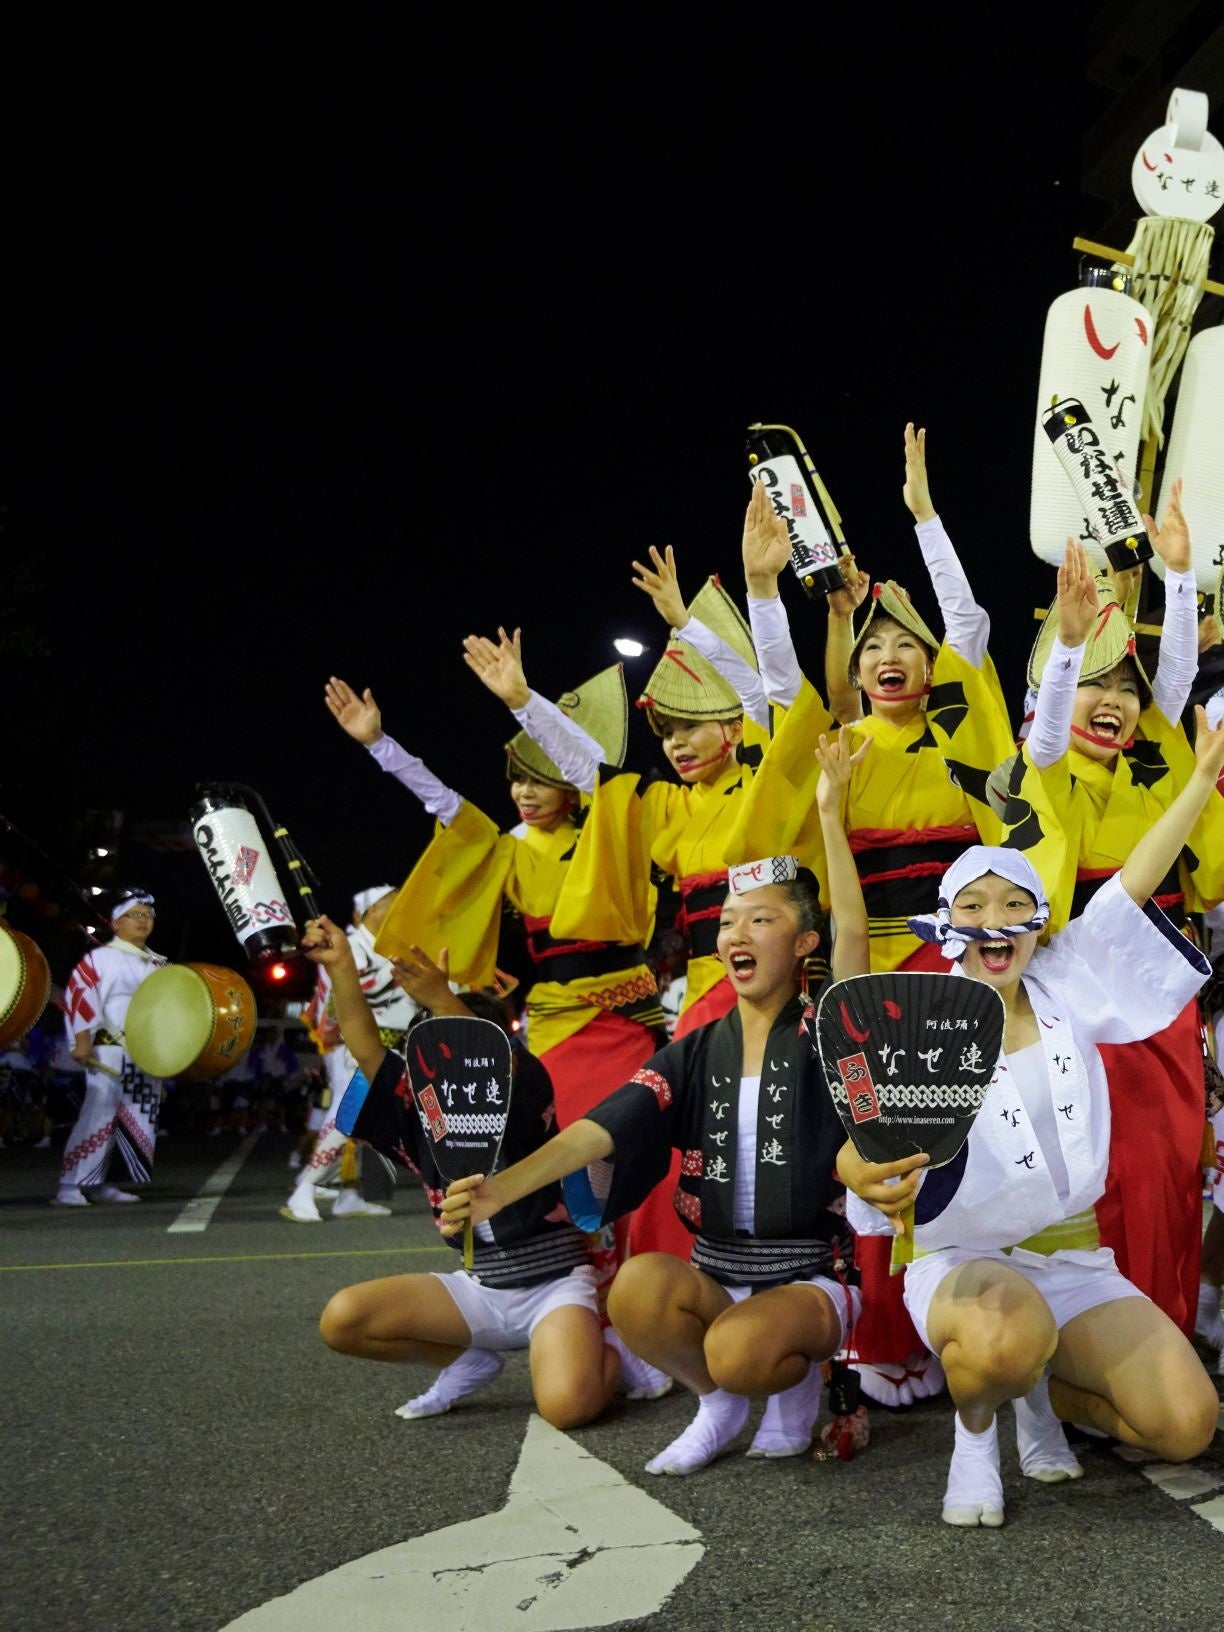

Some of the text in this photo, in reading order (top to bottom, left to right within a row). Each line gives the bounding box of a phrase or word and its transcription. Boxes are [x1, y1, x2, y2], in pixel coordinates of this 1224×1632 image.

[926, 1018, 978, 1030] 阿波踊り
[704, 1074, 731, 1183] いなせ連
[760, 1060, 790, 1165] いなせ連
[879, 1115, 955, 1126] http://www.inaseren.com
